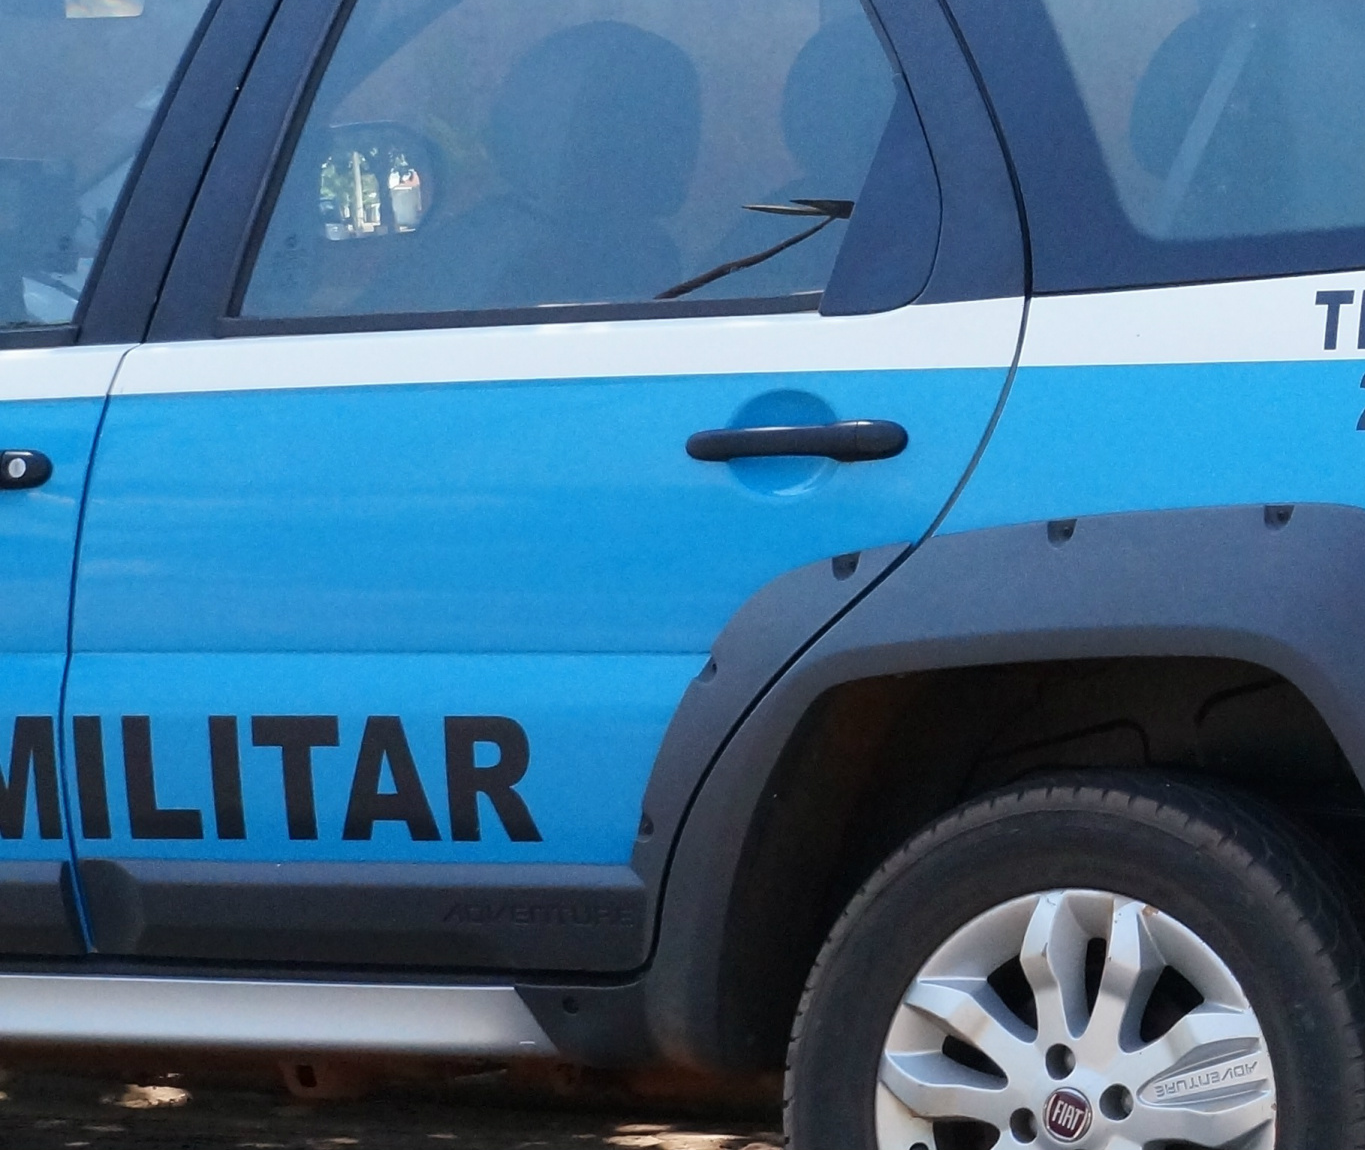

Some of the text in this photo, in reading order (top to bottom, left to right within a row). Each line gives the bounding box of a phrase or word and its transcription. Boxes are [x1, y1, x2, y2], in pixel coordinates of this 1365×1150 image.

[0, 715, 542, 842] MILITAR
[442, 903, 636, 928] ADVENTURE
[1154, 1061, 1258, 1098] ADVENTURE
[1051, 1099, 1085, 1130] FIAT
